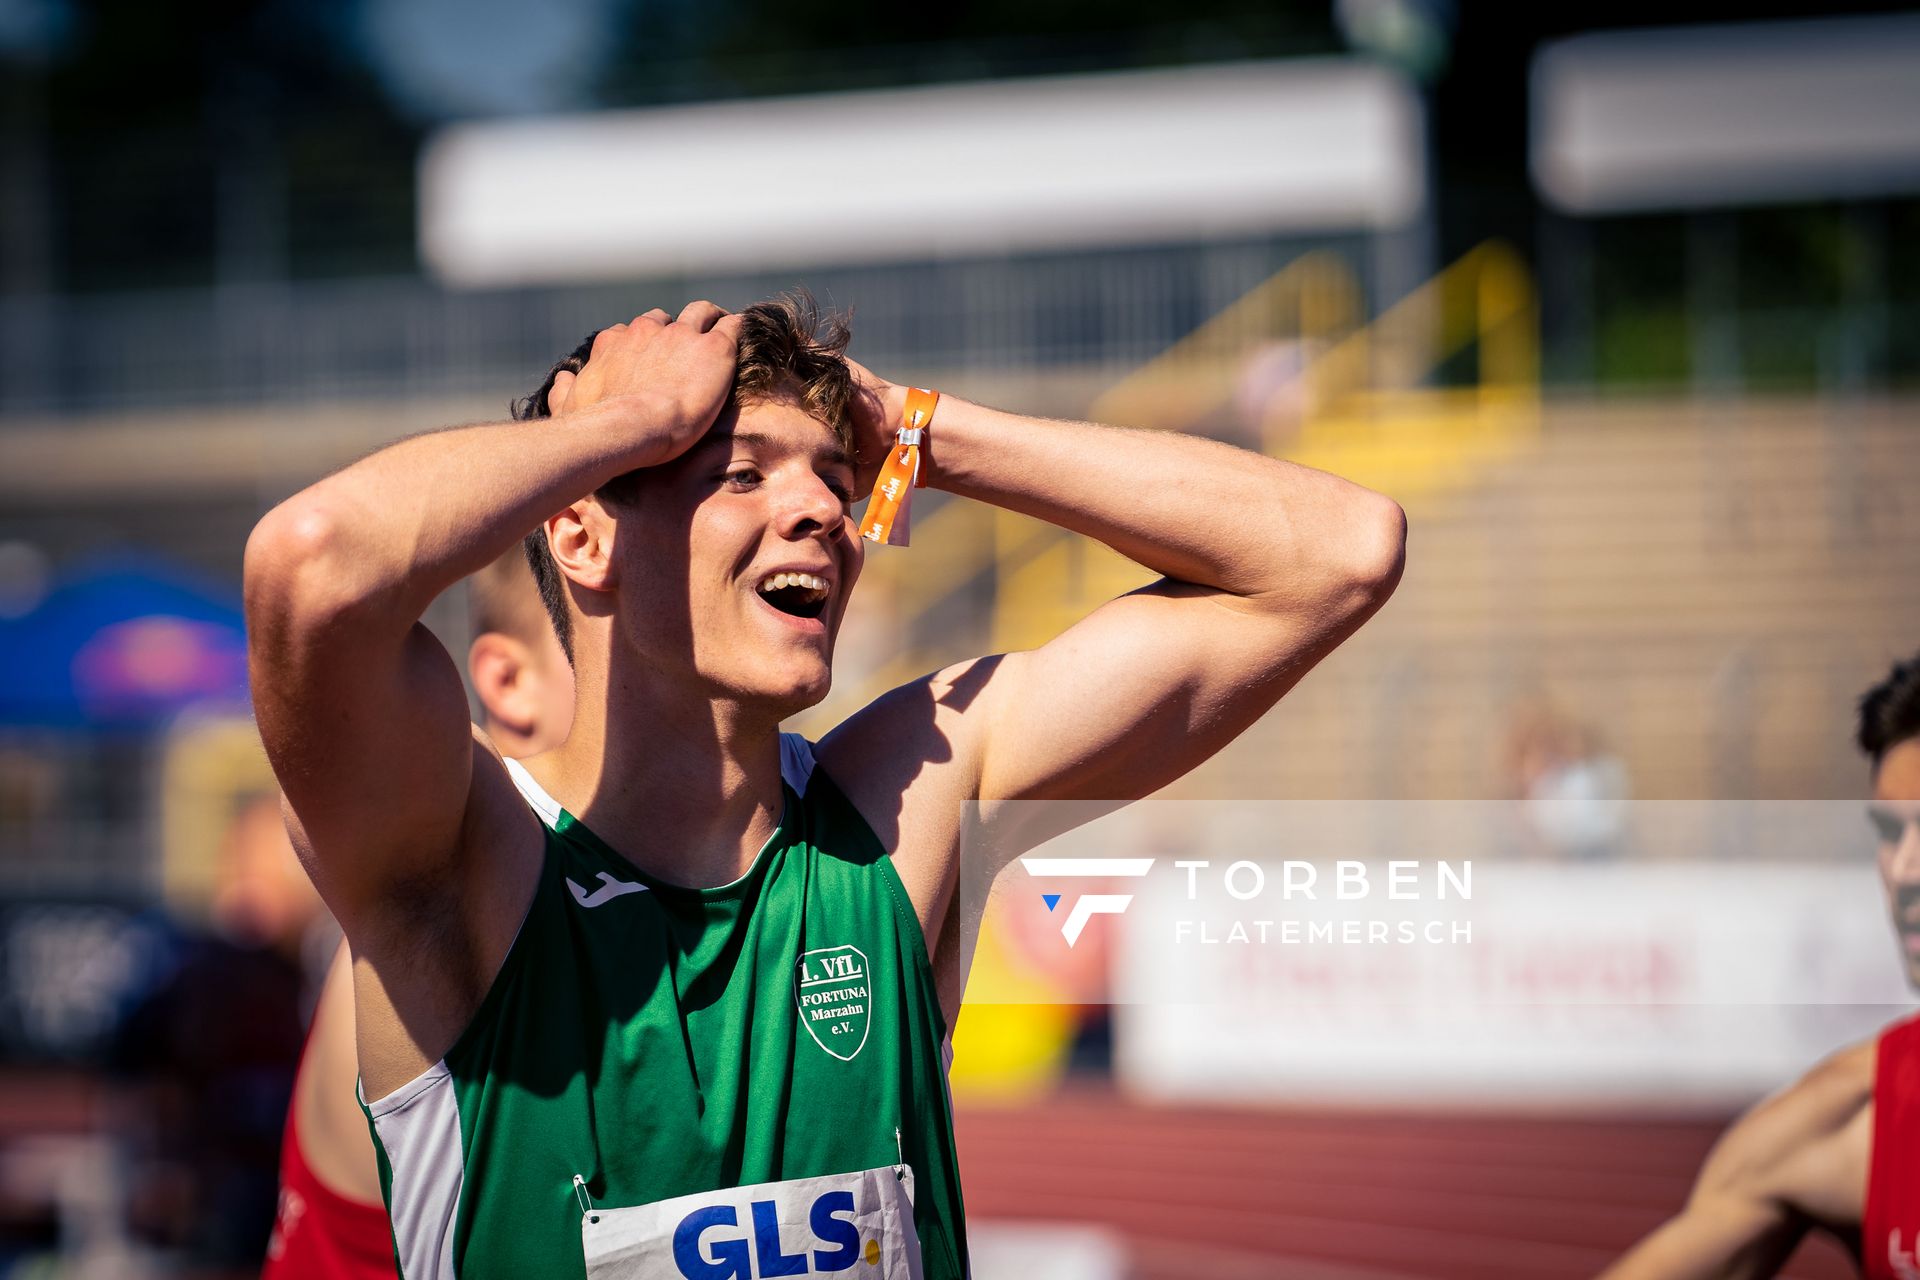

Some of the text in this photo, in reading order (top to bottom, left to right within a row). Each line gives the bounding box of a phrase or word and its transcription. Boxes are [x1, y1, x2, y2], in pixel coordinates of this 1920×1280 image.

[799, 954, 862, 982] 1. VfL
[801, 986, 867, 1007] FORTUNA
[810, 1004, 864, 1021] Marzahn
[831, 1021, 854, 1035] e.V.
